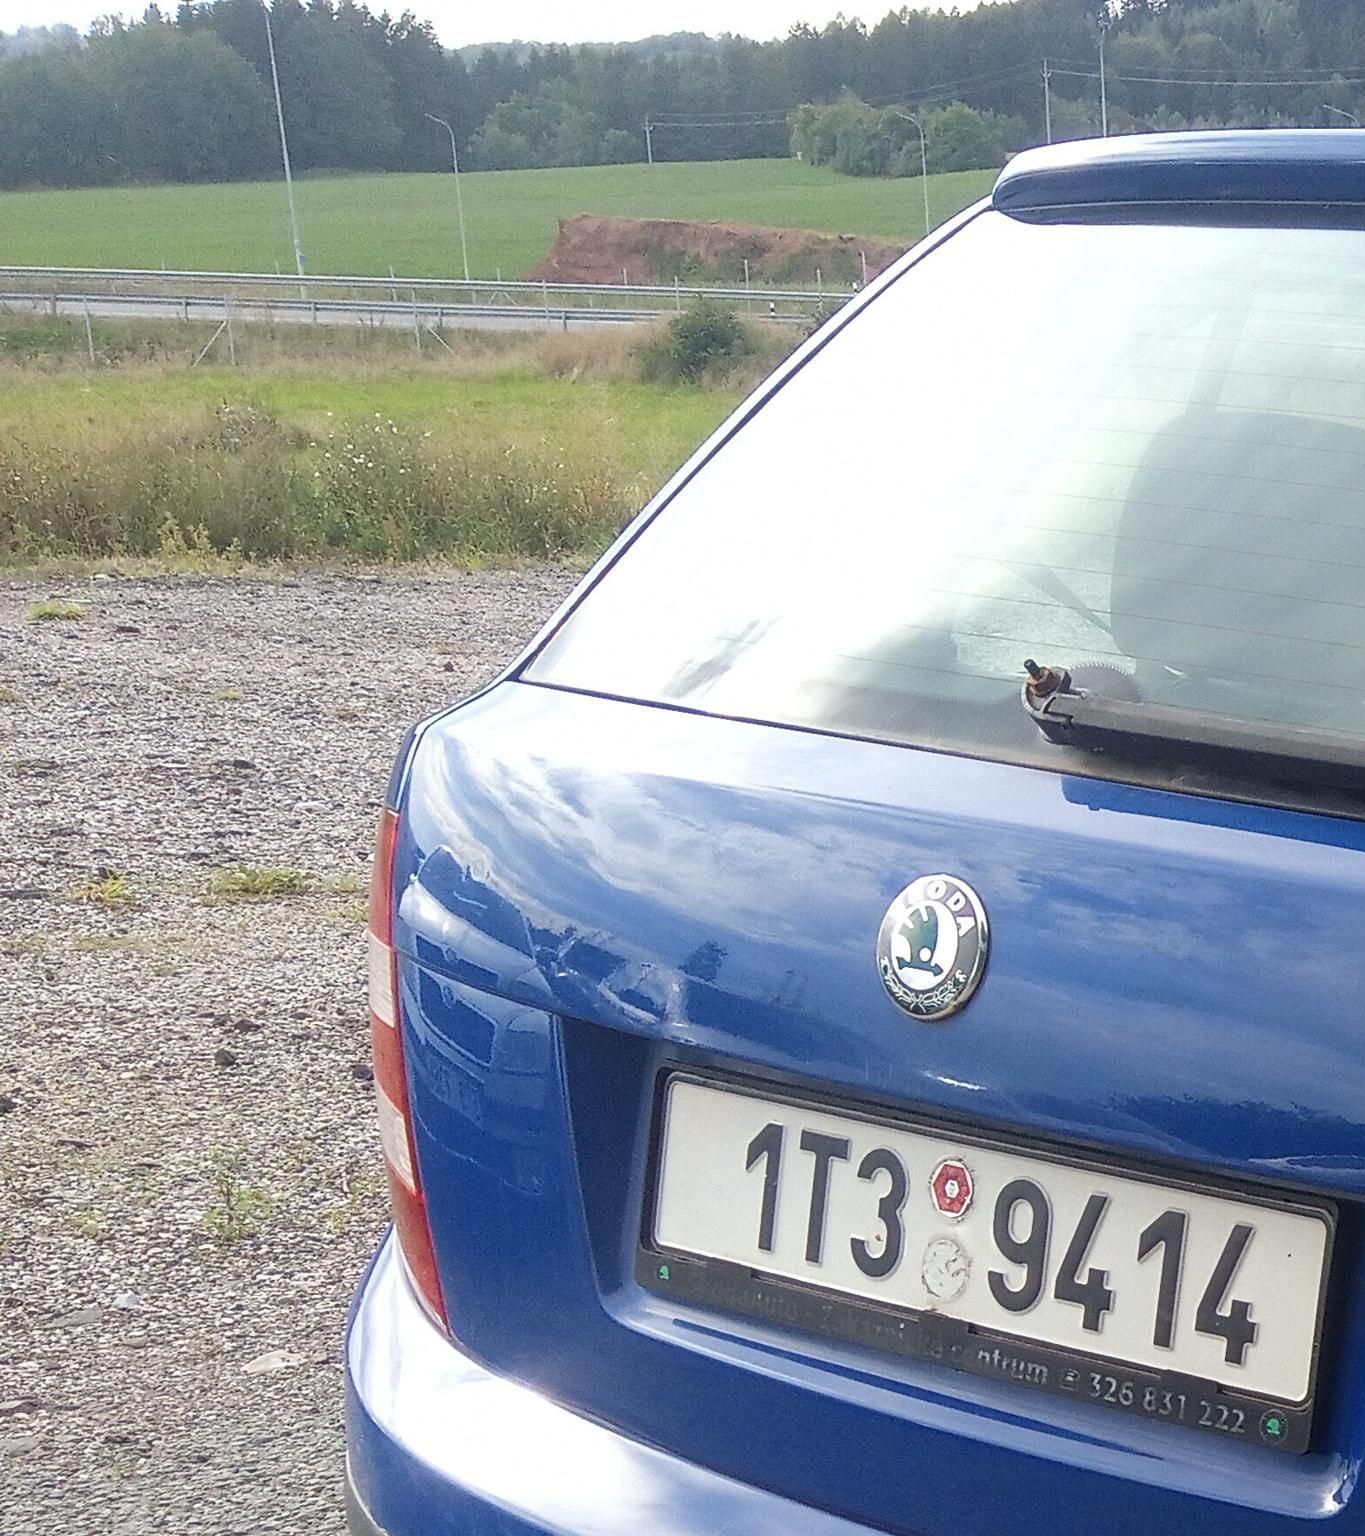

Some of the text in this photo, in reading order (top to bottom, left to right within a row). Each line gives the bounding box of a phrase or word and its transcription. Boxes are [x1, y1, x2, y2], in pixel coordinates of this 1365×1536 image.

[745, 1121, 906, 1278] 1T3
[987, 1178, 1259, 1365] 9414
[1088, 1371, 1135, 1405] 326
[1198, 1400, 1248, 1435] 222
